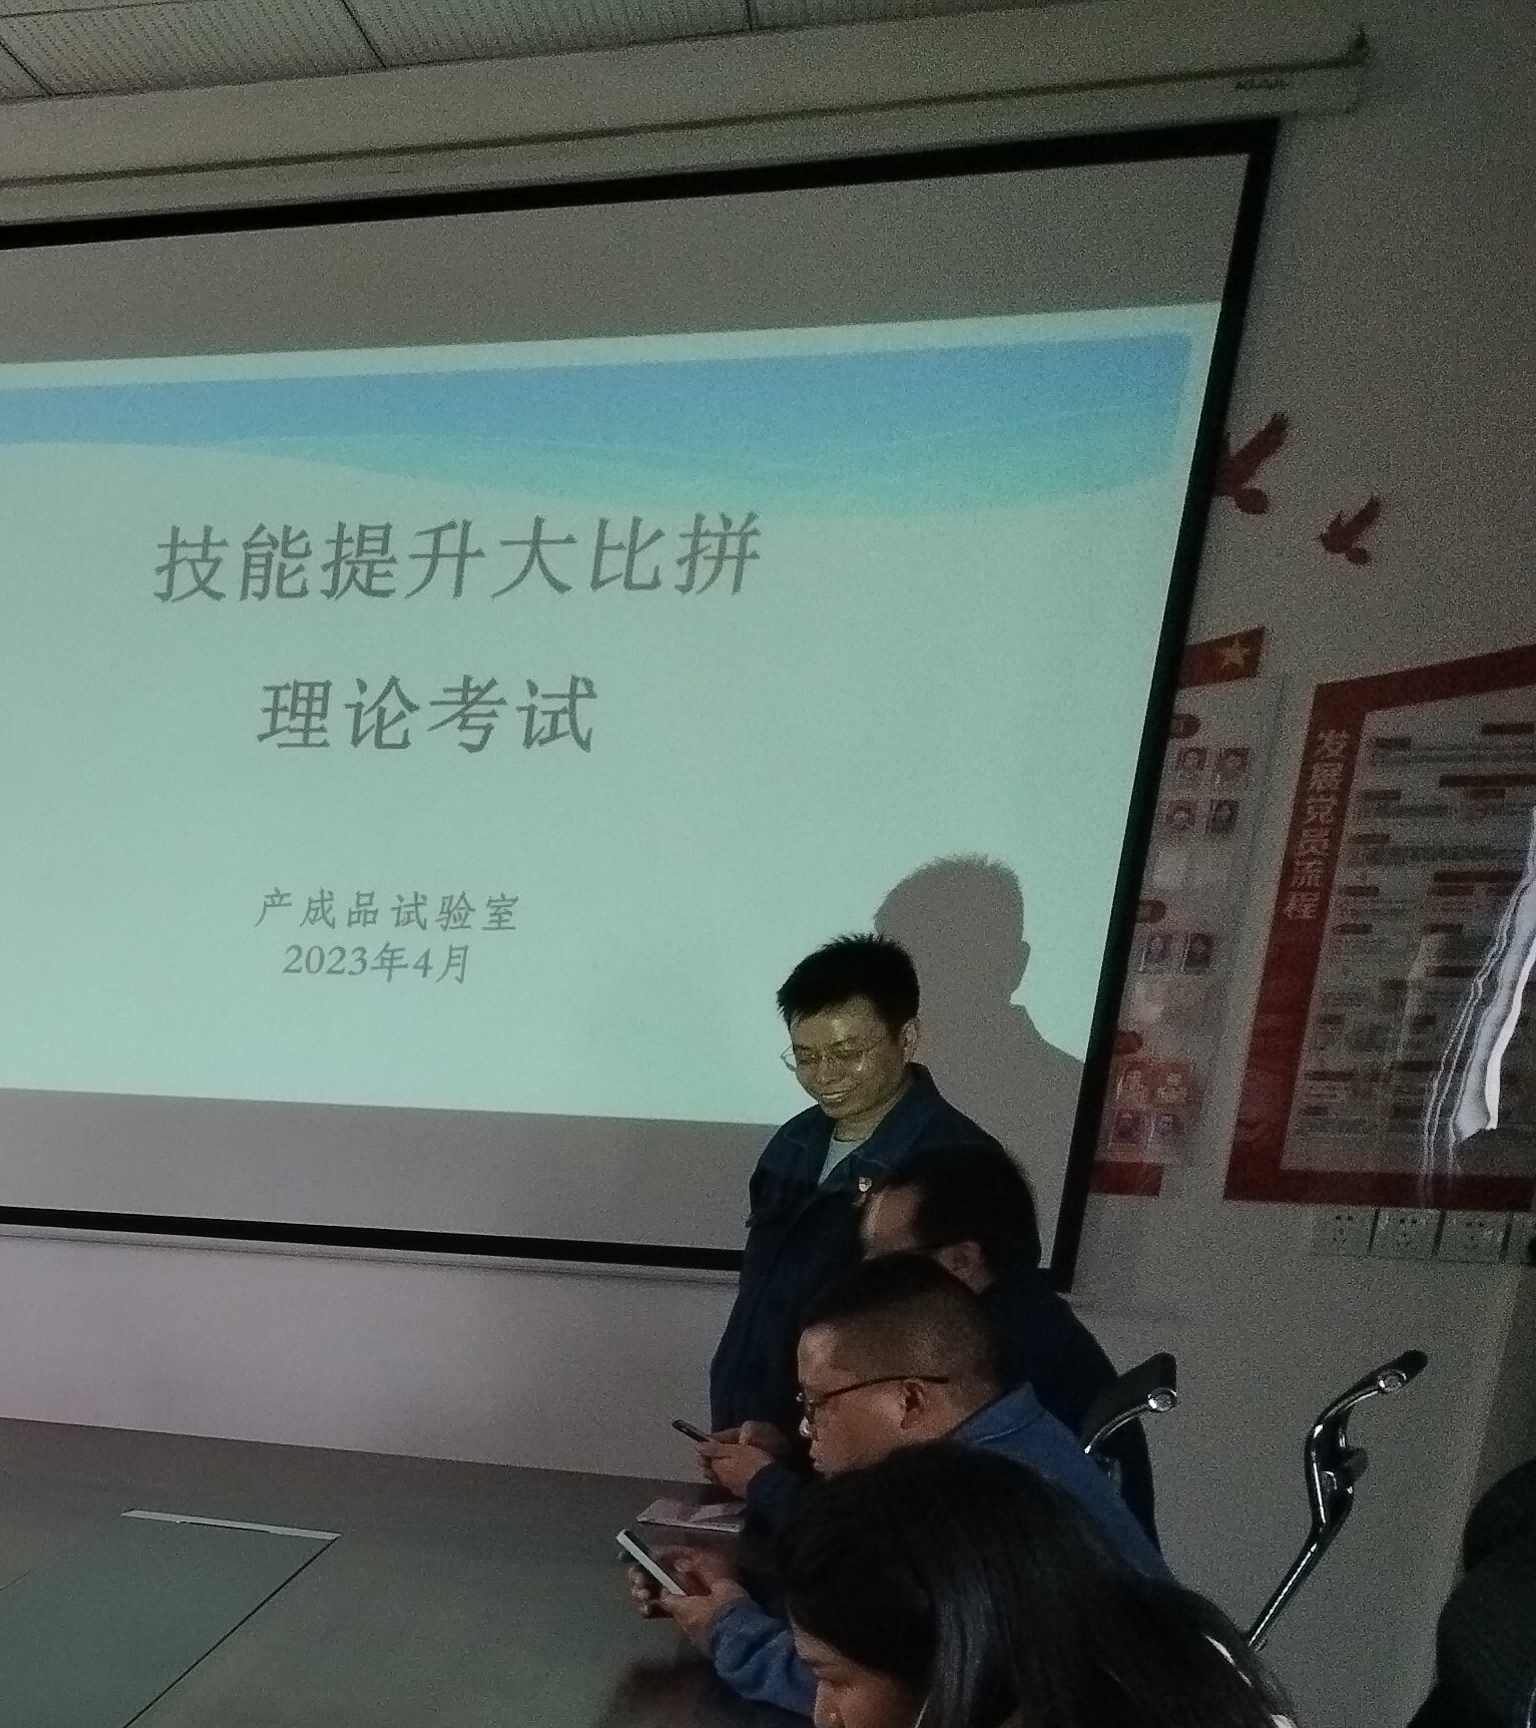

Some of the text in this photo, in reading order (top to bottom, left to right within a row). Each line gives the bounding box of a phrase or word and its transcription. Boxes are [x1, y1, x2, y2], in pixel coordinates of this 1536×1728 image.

[152, 510, 763, 604] 技能提升大比拼
[257, 672, 600, 756] 理论考试
[1283, 728, 1353, 921] 发展党员流程
[254, 886, 520, 933] 产成品试验室
[281, 942, 471, 985] 2023年4月
